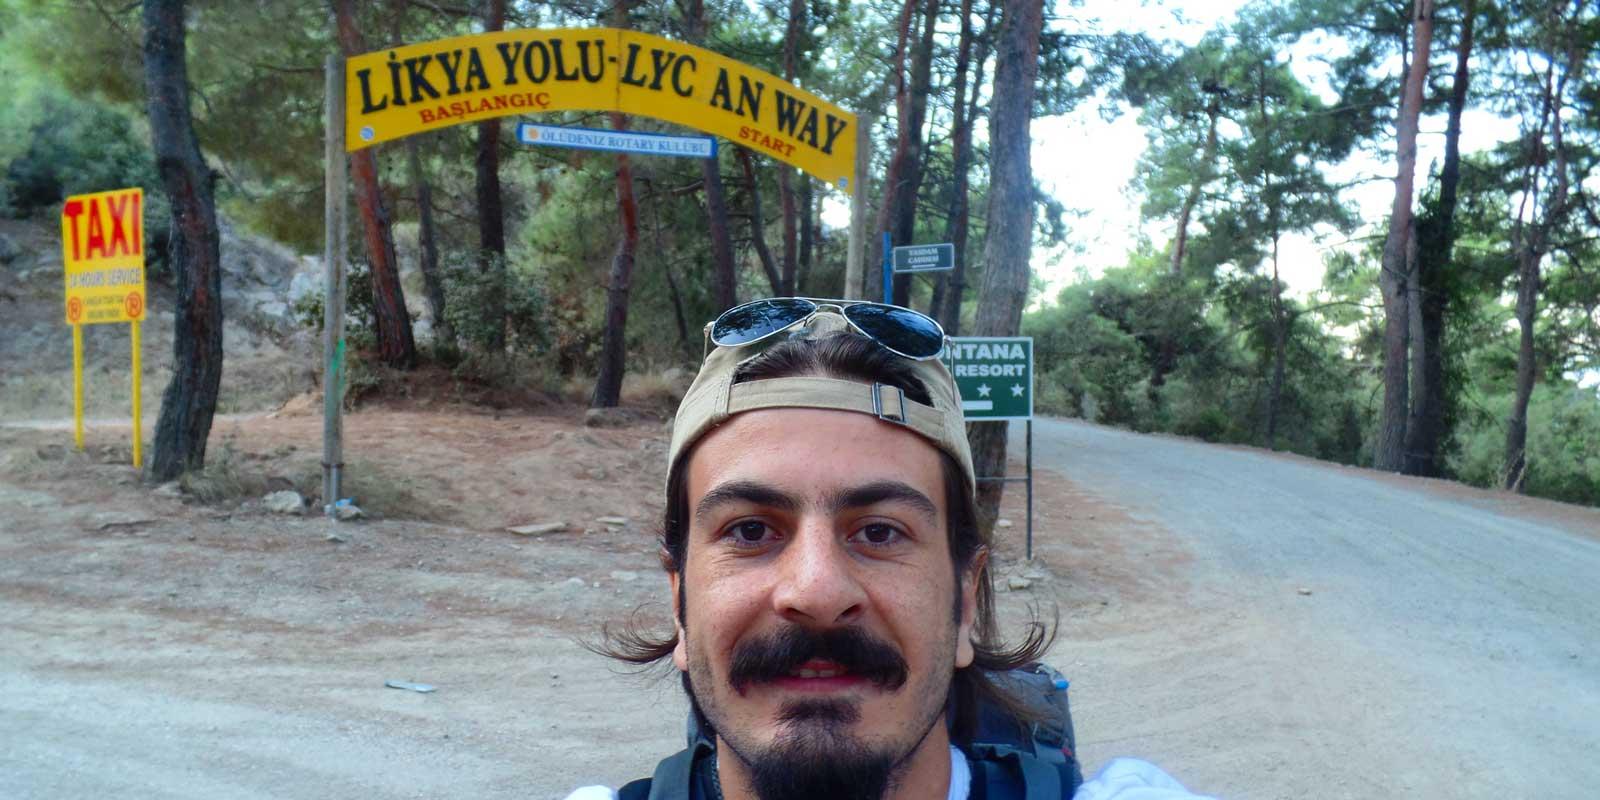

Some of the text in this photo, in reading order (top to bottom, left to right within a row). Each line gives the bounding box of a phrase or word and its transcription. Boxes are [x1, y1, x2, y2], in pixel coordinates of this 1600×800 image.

[356, 51, 491, 115] LİKYA
[775, 89, 847, 155] WAY
[419, 93, 551, 125] BAŞLANGIÇ
[608, 136, 654, 150] ROTARY
[738, 126, 796, 158] START
[64, 192, 141, 261] TAXI
[80, 270, 105, 288] HOURS
[108, 267, 142, 286] SERVICE
[941, 343, 1026, 360] NTANA
[955, 364, 1026, 377] RESORT
